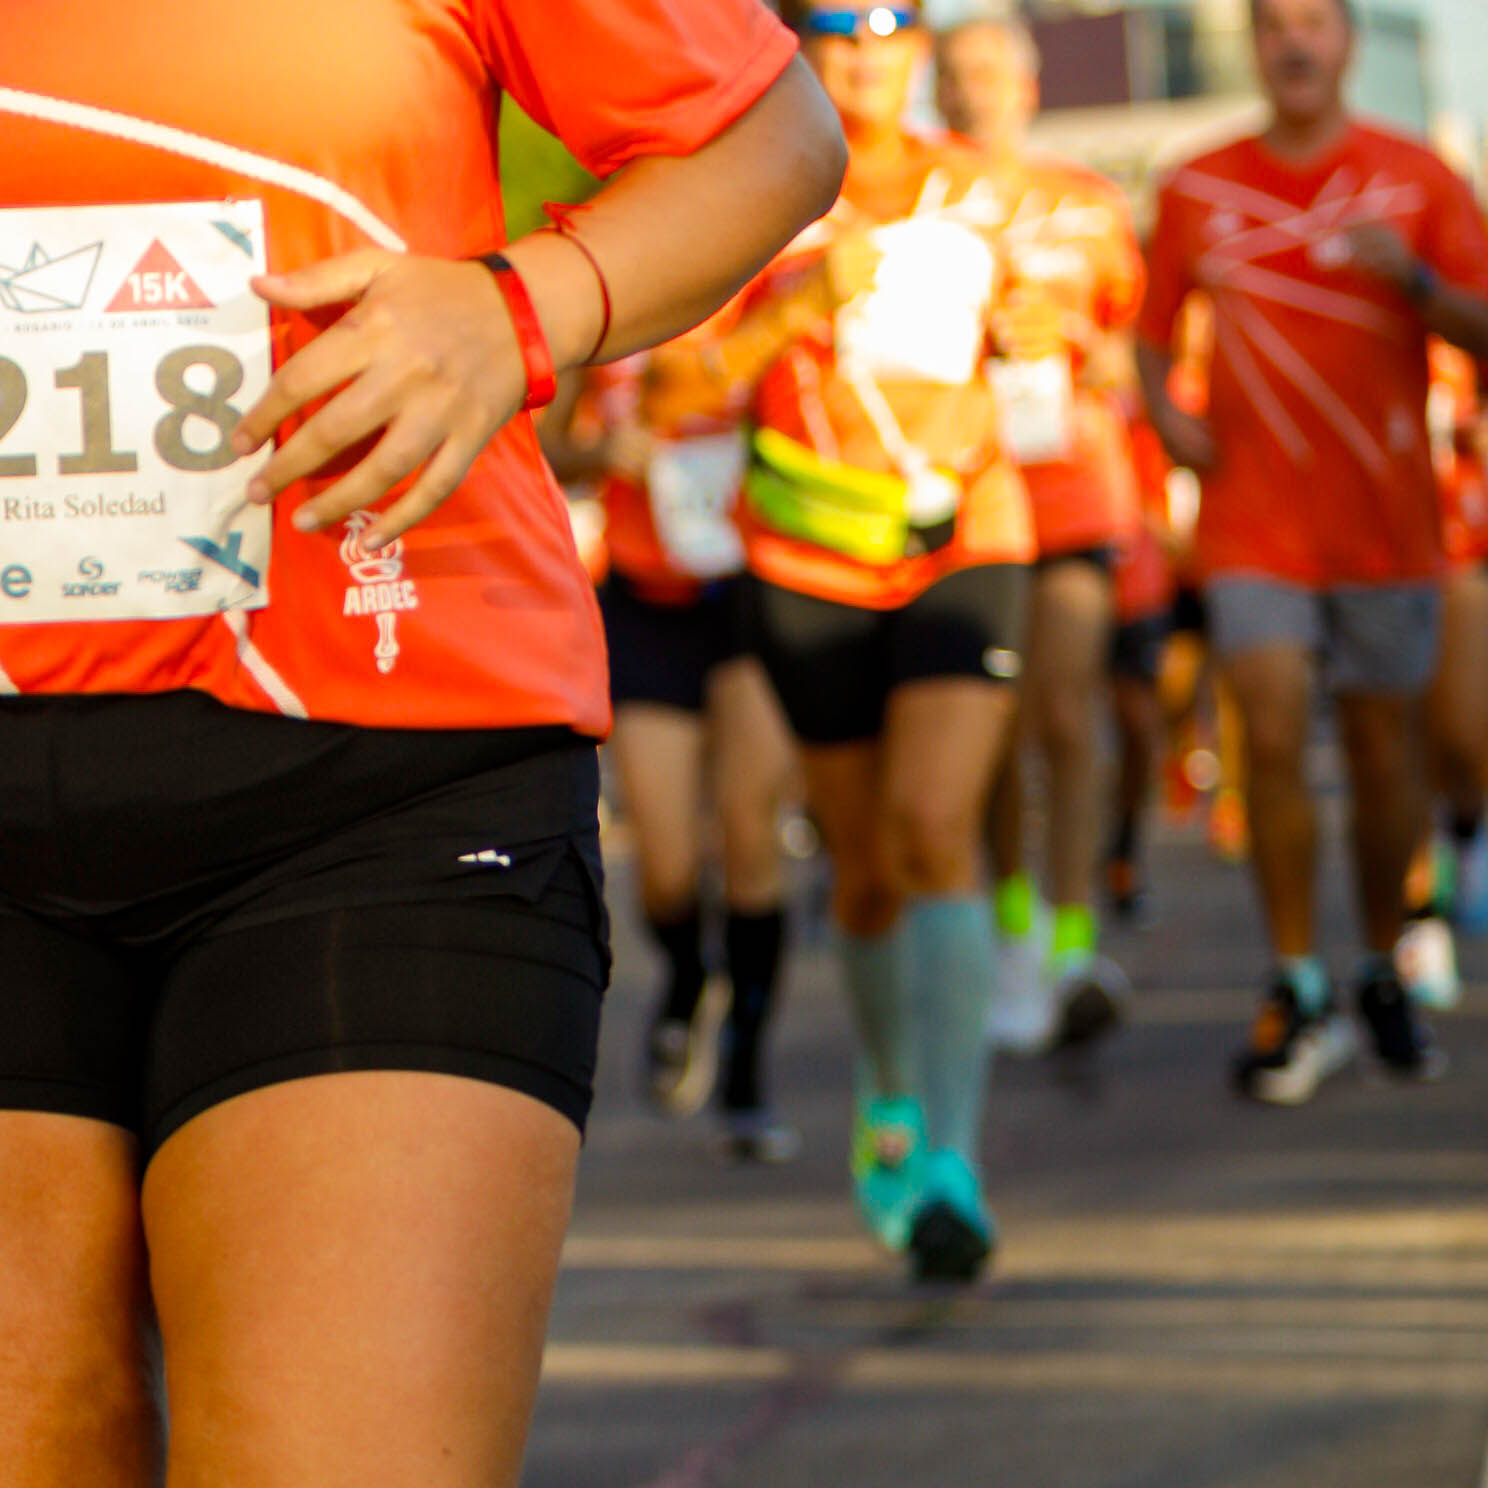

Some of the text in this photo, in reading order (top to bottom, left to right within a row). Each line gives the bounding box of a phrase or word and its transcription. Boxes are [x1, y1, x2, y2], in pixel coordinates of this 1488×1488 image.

[126, 272, 190, 304] 15K
[4, 495, 56, 521] Rita
[63, 490, 167, 518] Soledad
